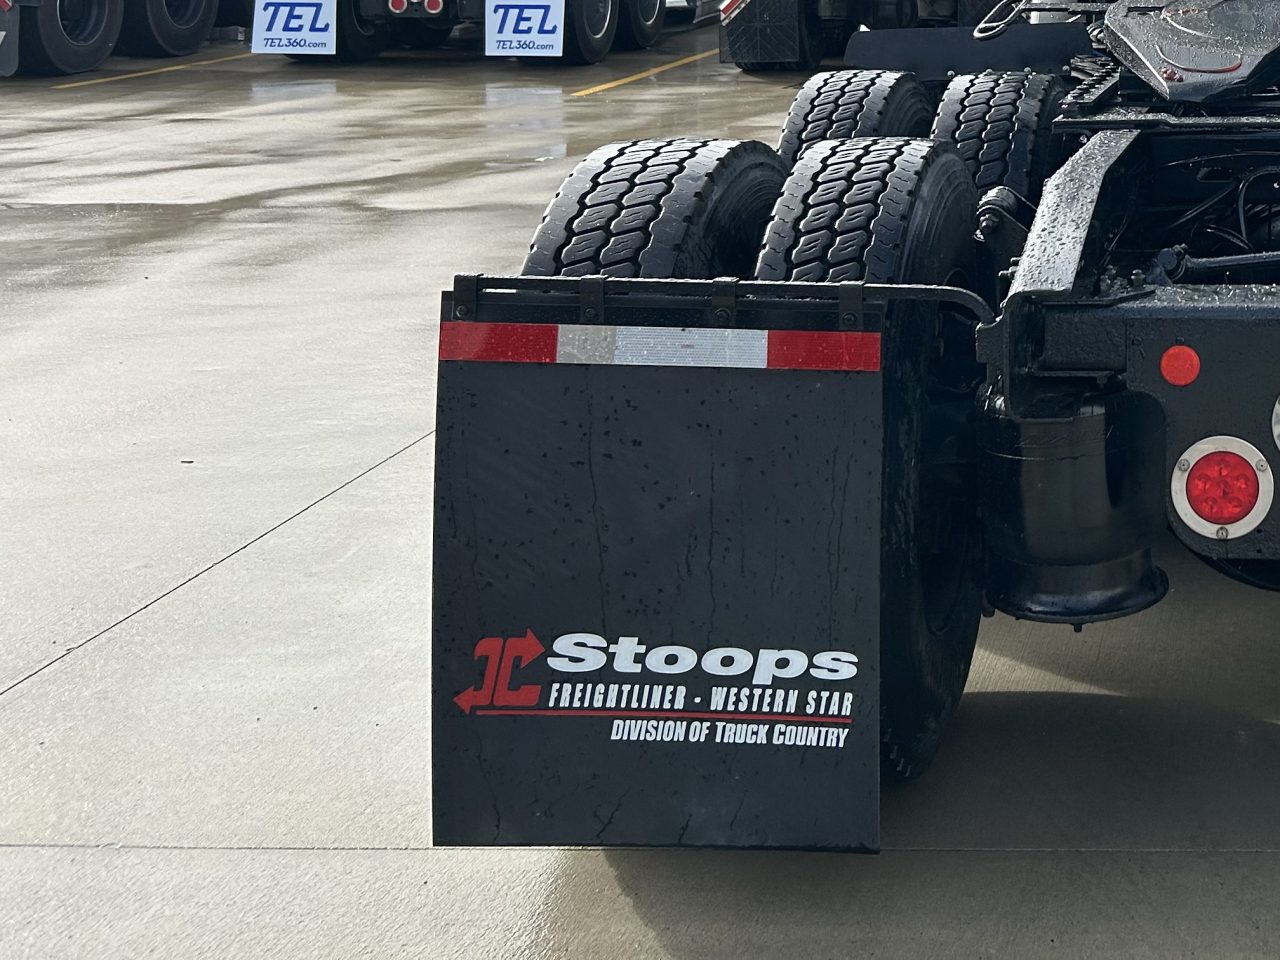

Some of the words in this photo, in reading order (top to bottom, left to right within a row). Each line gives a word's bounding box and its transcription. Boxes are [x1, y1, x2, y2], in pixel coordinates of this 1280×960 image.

[262, 1, 330, 33] TEL
[493, 4, 558, 35] TEL
[263, 37, 327, 49] TEL360.com
[495, 39, 554, 51] TEL360.com
[546, 632, 859, 686] Stoops
[548, 682, 687, 710] FREIGHTLINER
[710, 686, 799, 714] WESTERN
[806, 689, 853, 716] STAR
[610, 719, 687, 742] DIVISION
[688, 720, 711, 743] OF
[715, 721, 770, 745] TRUCK
[772, 723, 850, 748] COUNTRY
